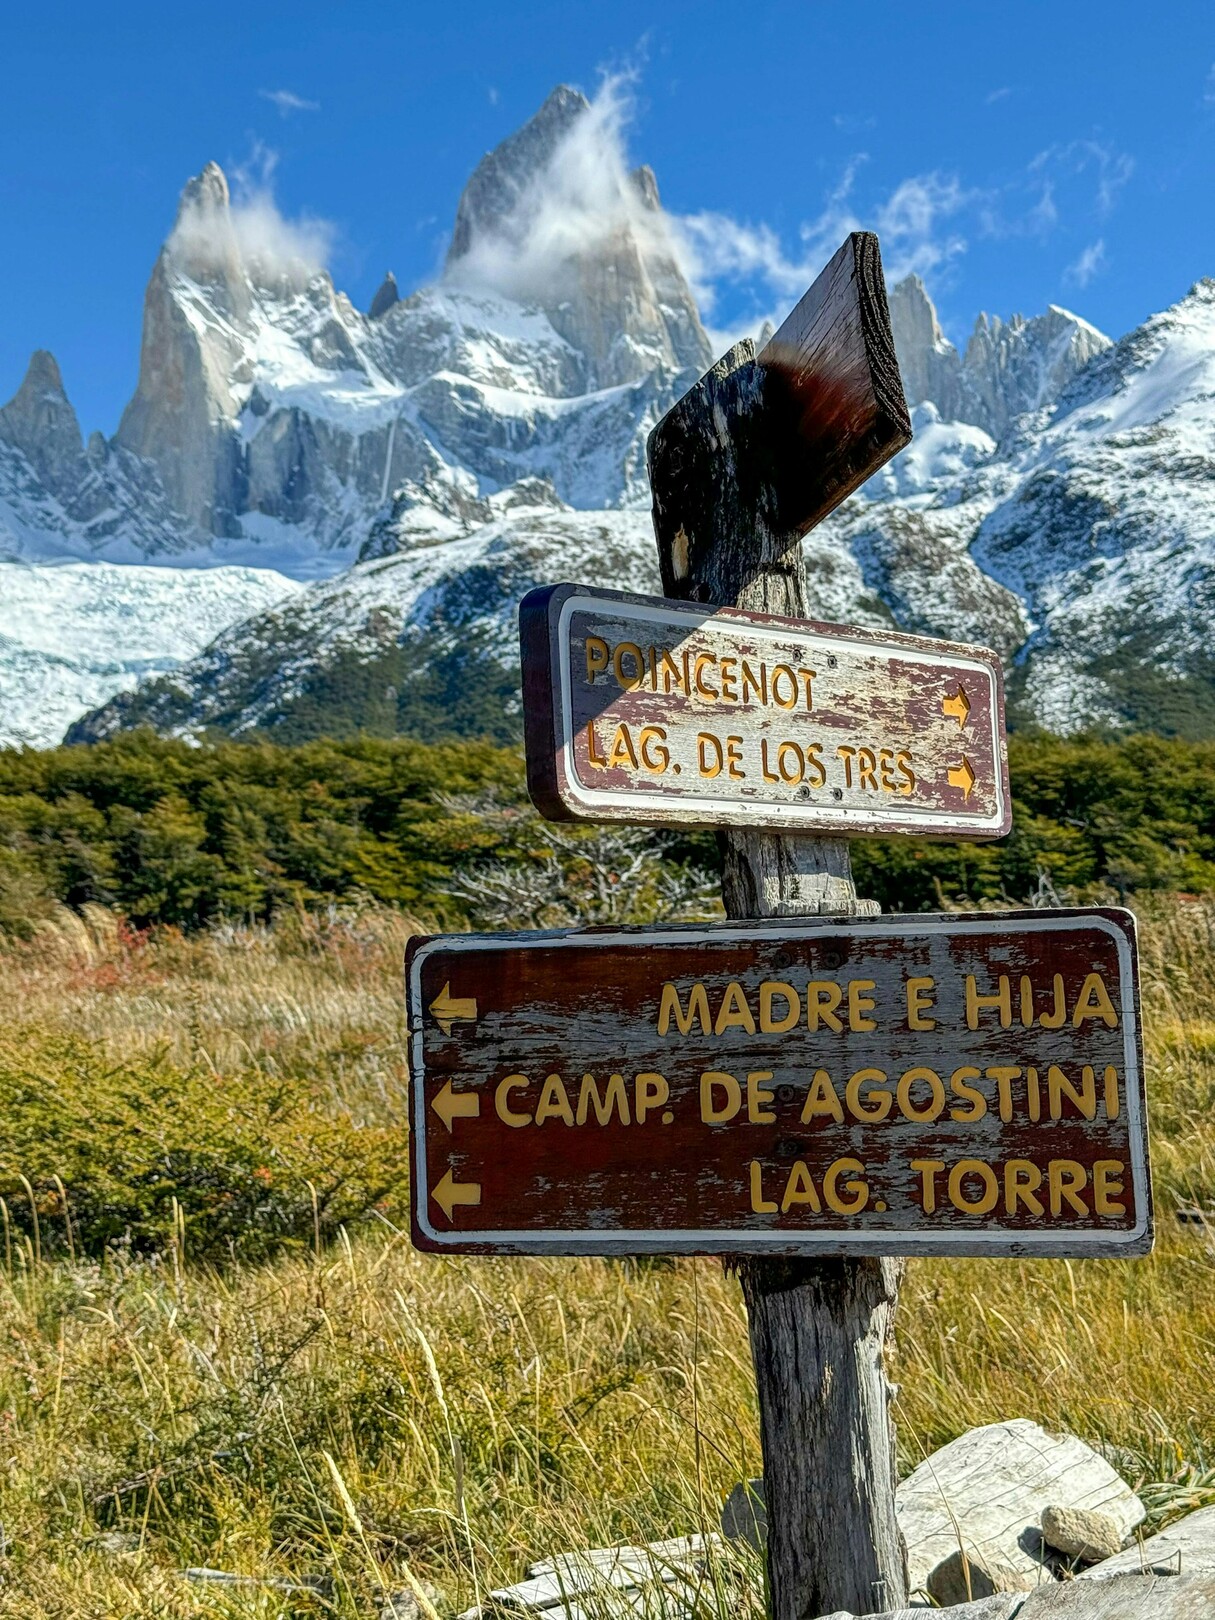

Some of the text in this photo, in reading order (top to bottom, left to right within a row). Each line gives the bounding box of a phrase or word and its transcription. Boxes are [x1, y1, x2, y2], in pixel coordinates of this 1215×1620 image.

[585, 637, 817, 711] POINCENOT
[586, 719, 916, 795] LAG. DE LOS TRES
[657, 973, 1118, 1036] MADRE E HIJA
[494, 1065, 1120, 1127] CAMP. DE AGOSTINI
[750, 1157, 1126, 1217] LAG. TORRE
